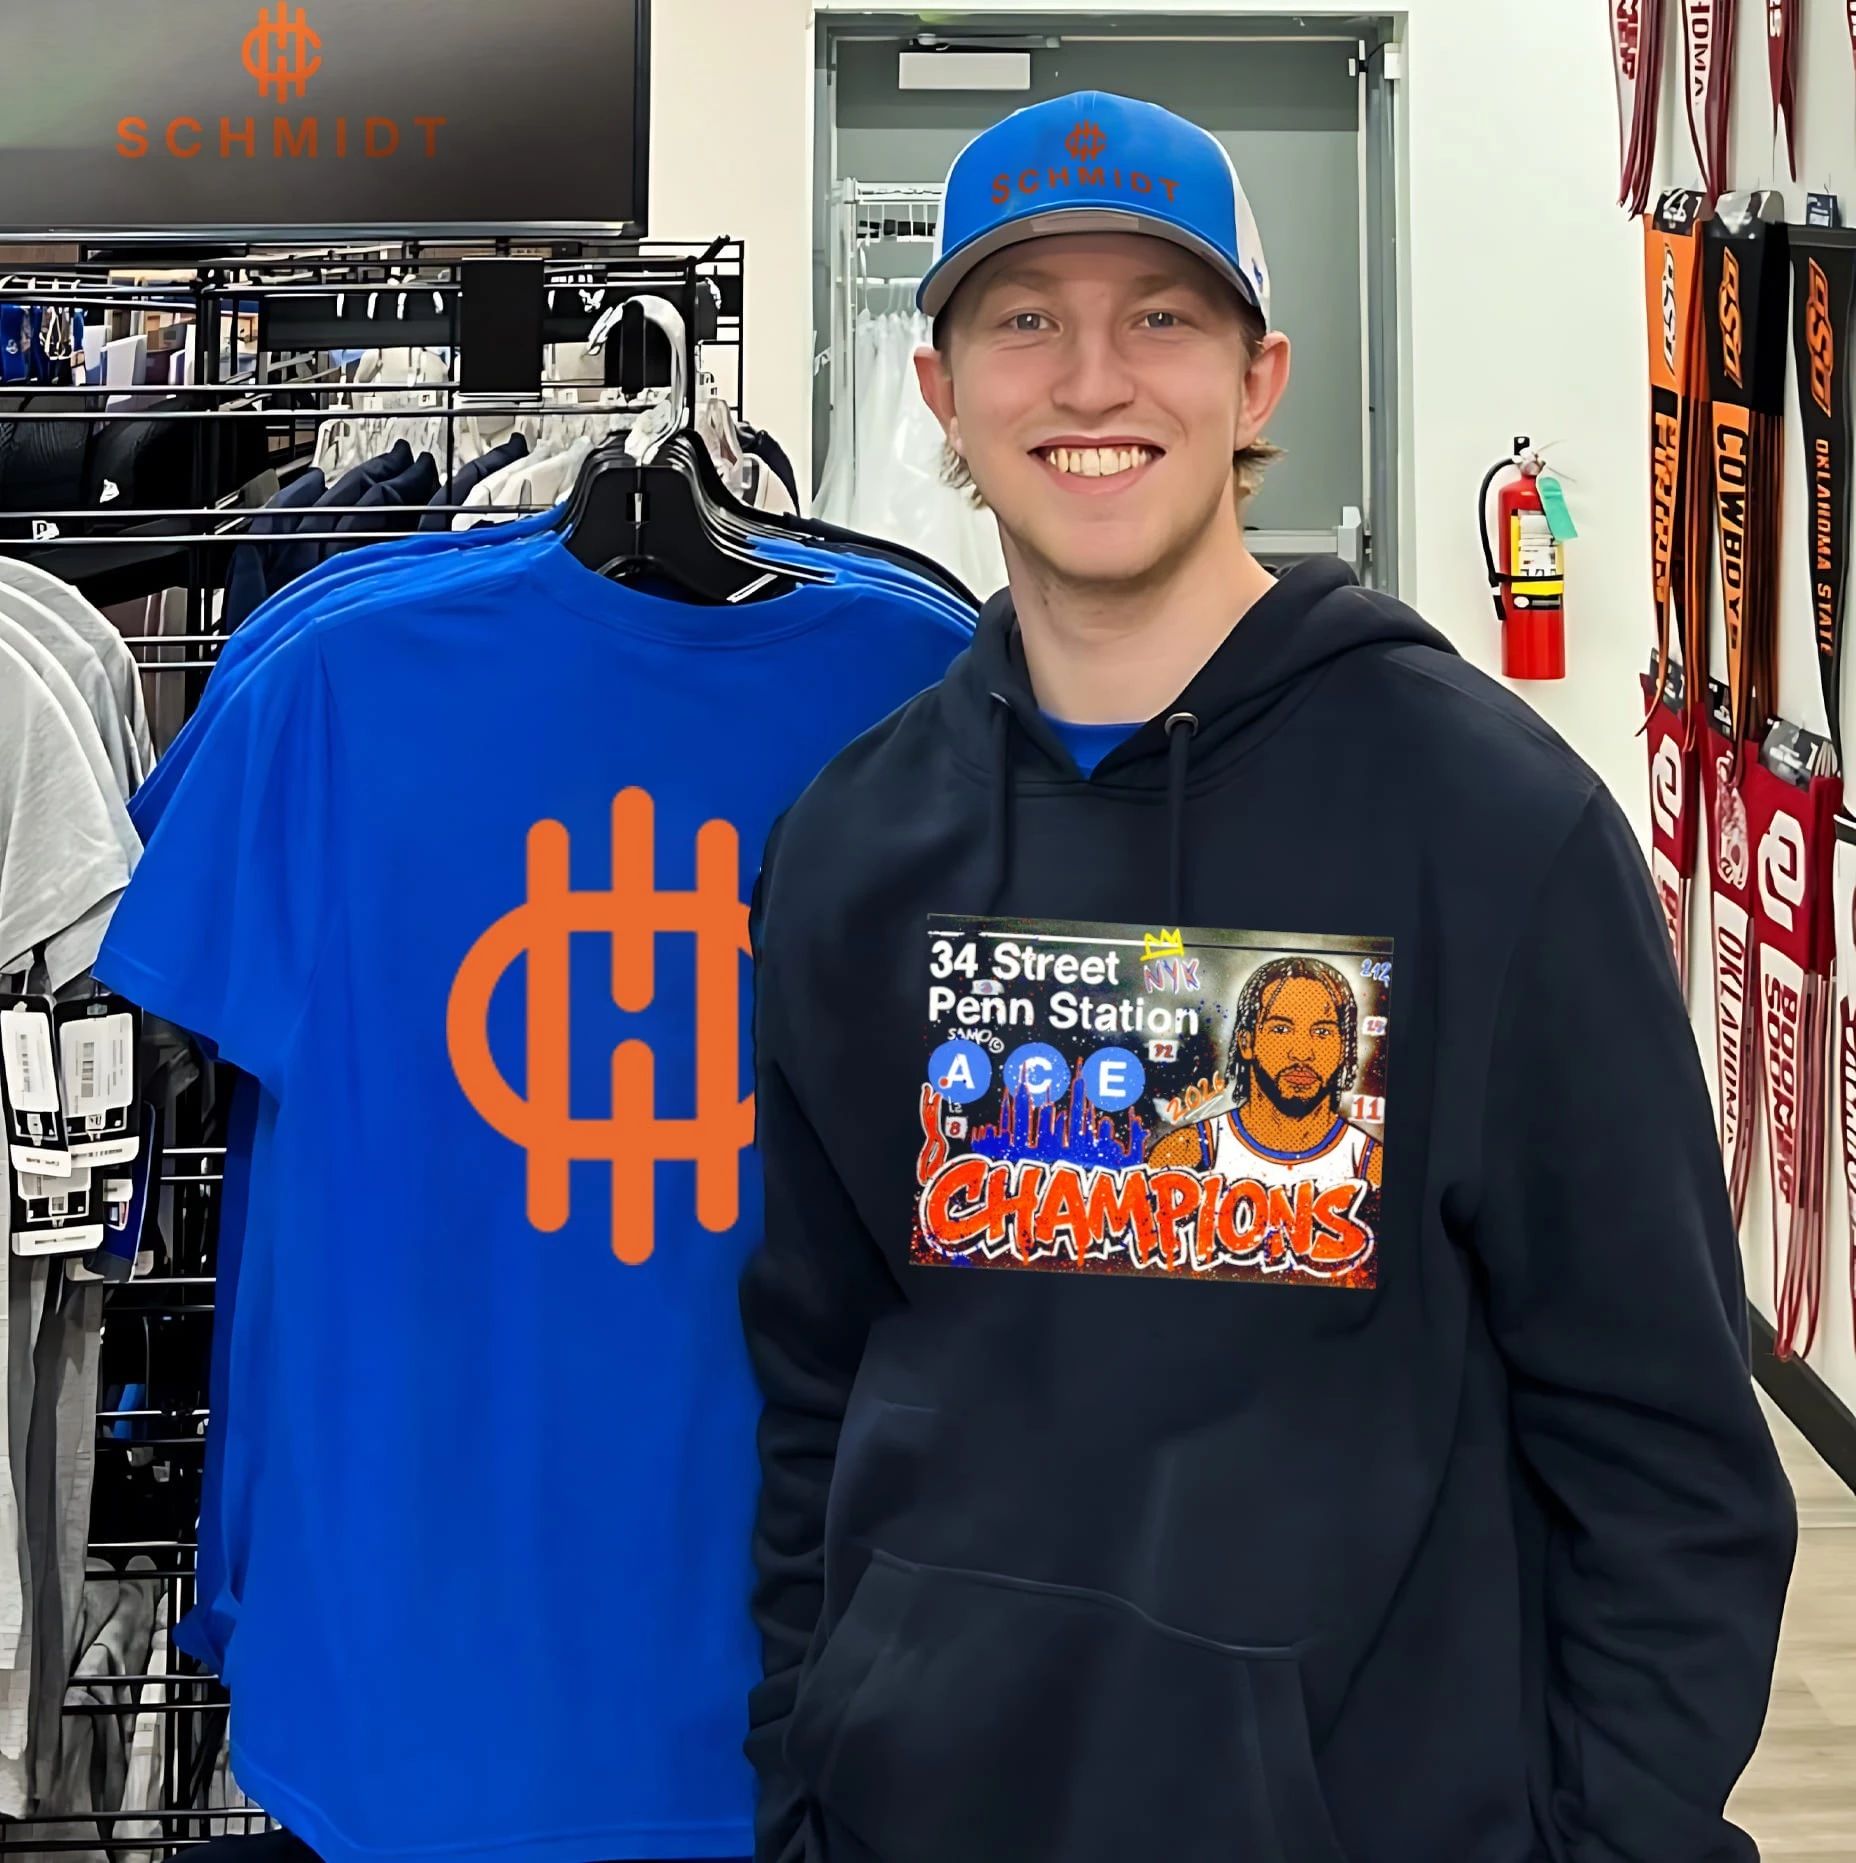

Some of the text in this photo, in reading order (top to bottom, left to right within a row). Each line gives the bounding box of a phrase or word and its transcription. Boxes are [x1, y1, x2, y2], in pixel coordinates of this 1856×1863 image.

[115, 116, 448, 159] SCHMIDT
[991, 166, 1181, 204] SCHMIDT
[929, 939, 1120, 985] 34 Street
[1143, 957, 1201, 994] NYK
[928, 985, 1199, 1036] Penn Station
[943, 1053, 1128, 1098] A C E
[1353, 1096, 1382, 1120] 11
[922, 1158, 1370, 1272] CHAMPIONS
